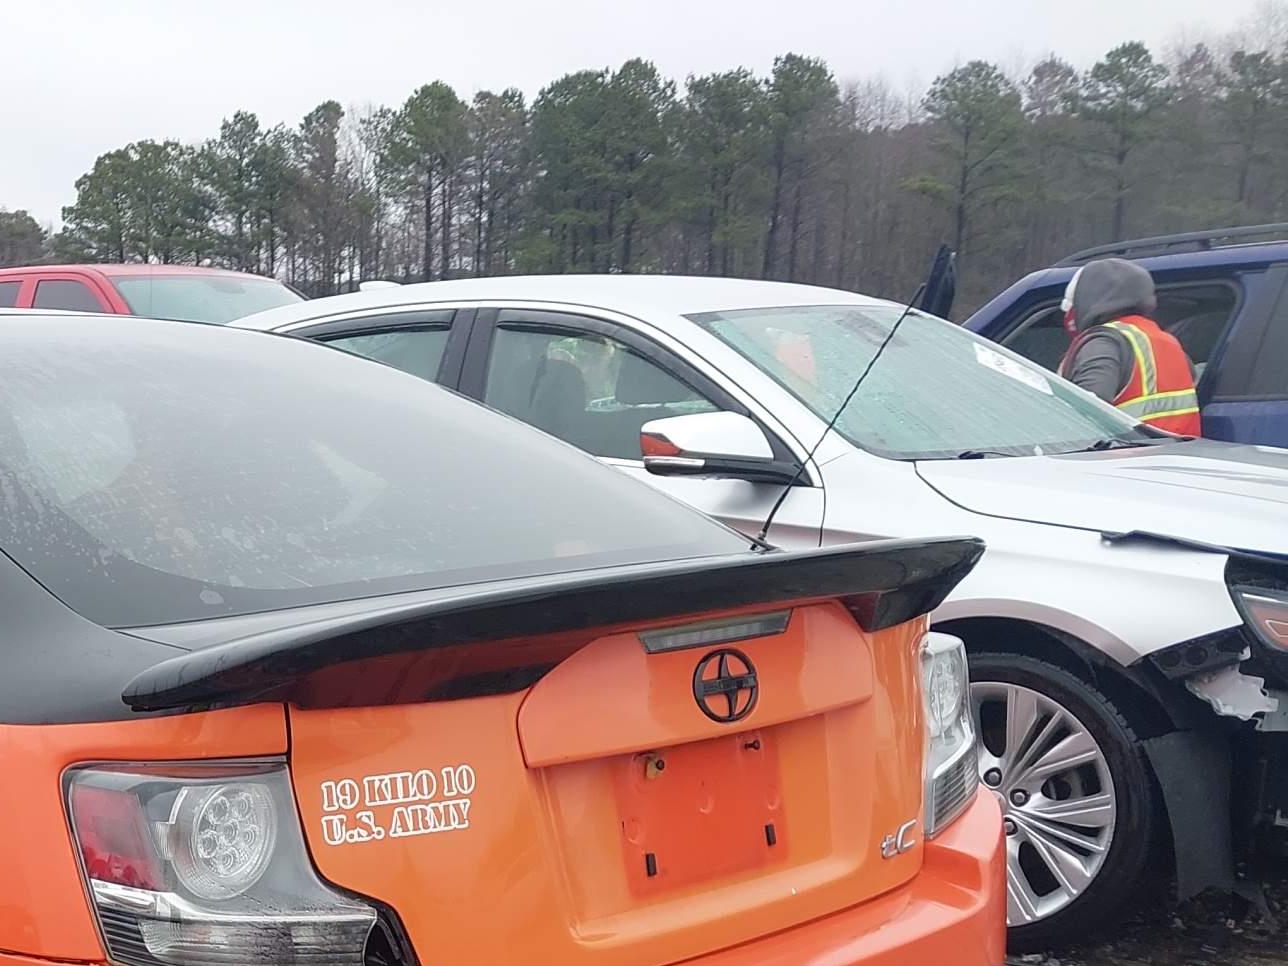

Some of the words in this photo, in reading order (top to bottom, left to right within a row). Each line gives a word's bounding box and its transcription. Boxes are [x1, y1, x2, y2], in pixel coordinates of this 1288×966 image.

[321, 779, 359, 811] 19
[363, 769, 437, 806] KILO
[441, 764, 476, 796] 10
[321, 811, 385, 845] U.S.
[389, 798, 471, 837] ARMY
